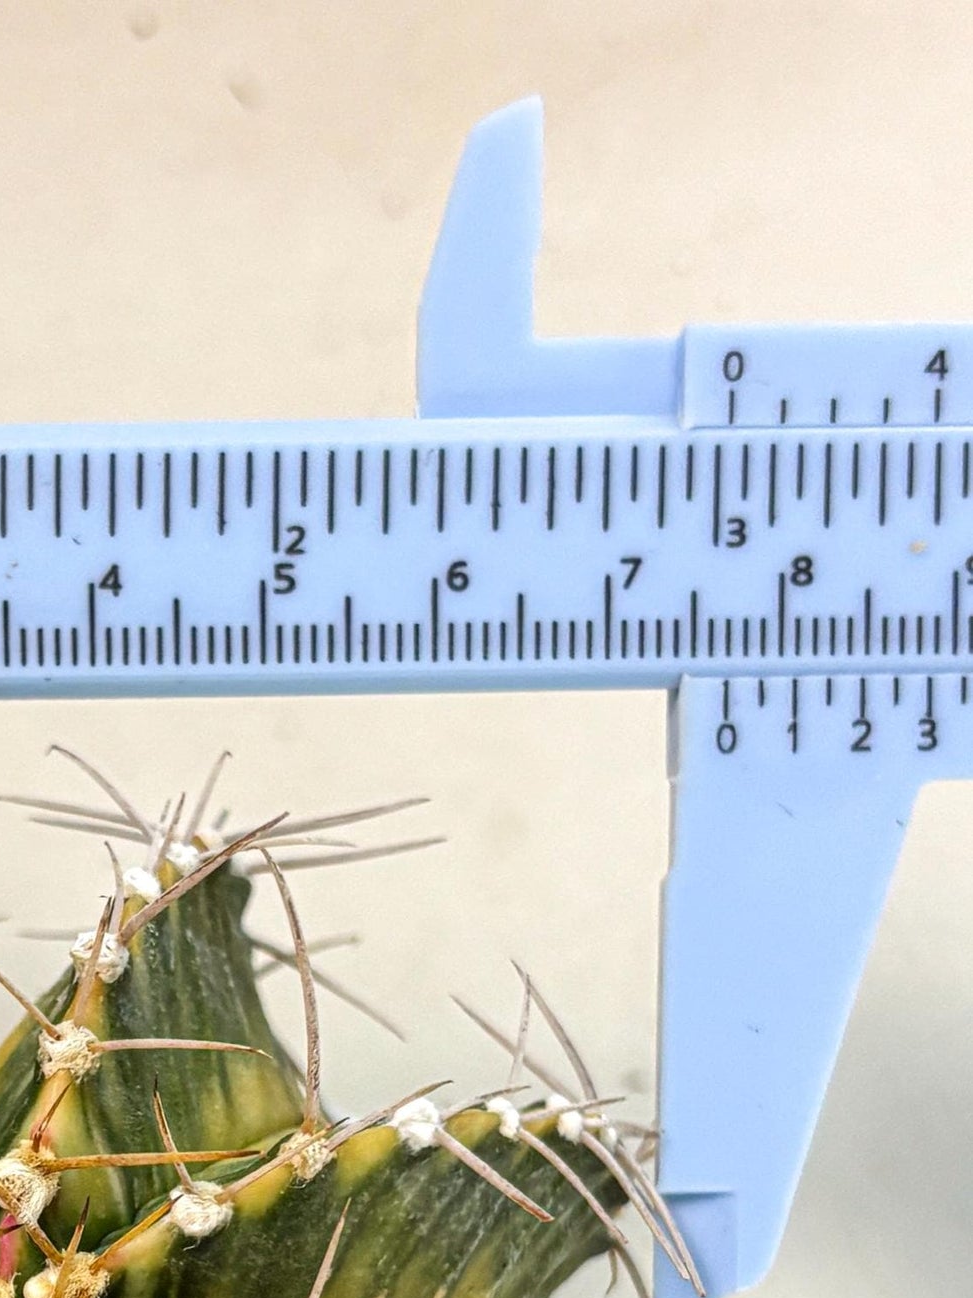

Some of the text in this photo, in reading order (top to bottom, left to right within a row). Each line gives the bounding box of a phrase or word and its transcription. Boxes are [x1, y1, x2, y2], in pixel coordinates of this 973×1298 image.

[722, 349, 950, 383] 0 4
[283, 525, 307, 556] 2
[725, 517, 748, 549] 3
[98, 563, 124, 597] 4
[273, 562, 298, 595] 5
[445, 560, 471, 593] 6
[619, 556, 644, 590] 7
[789, 555, 815, 587] 8
[716, 717, 939, 754] 0 1 2 3
